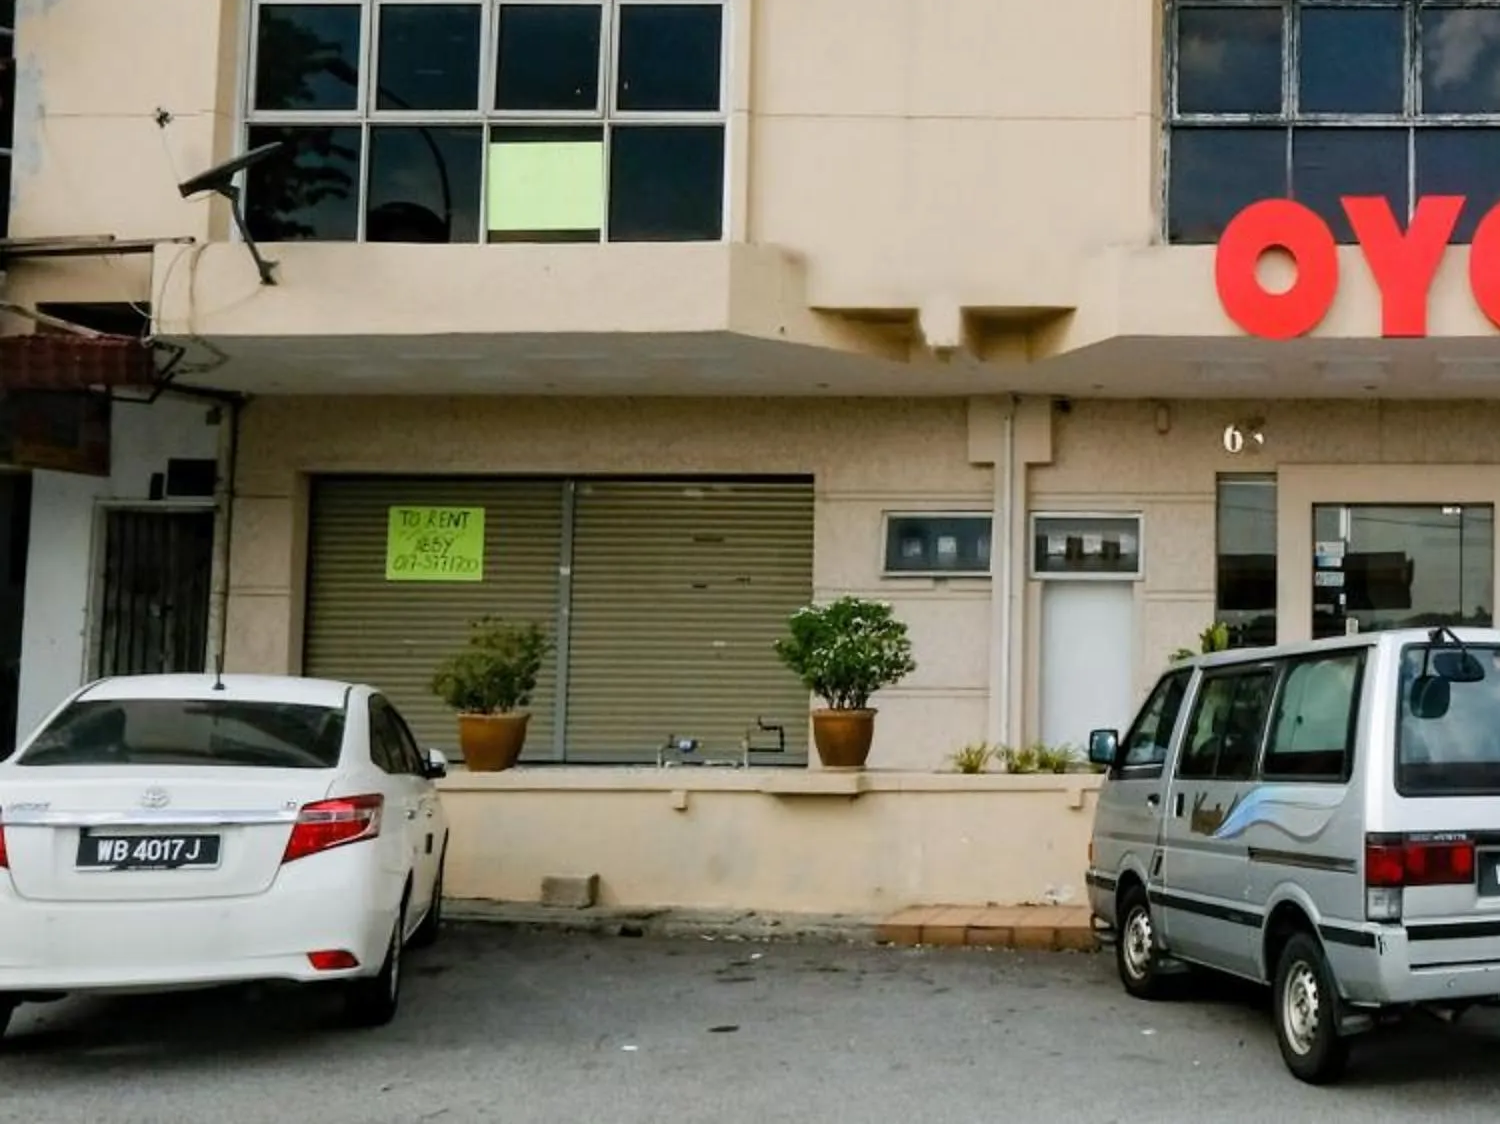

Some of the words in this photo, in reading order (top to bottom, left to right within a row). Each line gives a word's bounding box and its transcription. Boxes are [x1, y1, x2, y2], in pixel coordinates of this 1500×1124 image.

[399, 509, 422, 527] TO
[425, 509, 472, 529] RENT
[98, 839, 129, 862] WB
[132, 839, 185, 861] 4017
[185, 838, 201, 860] J
